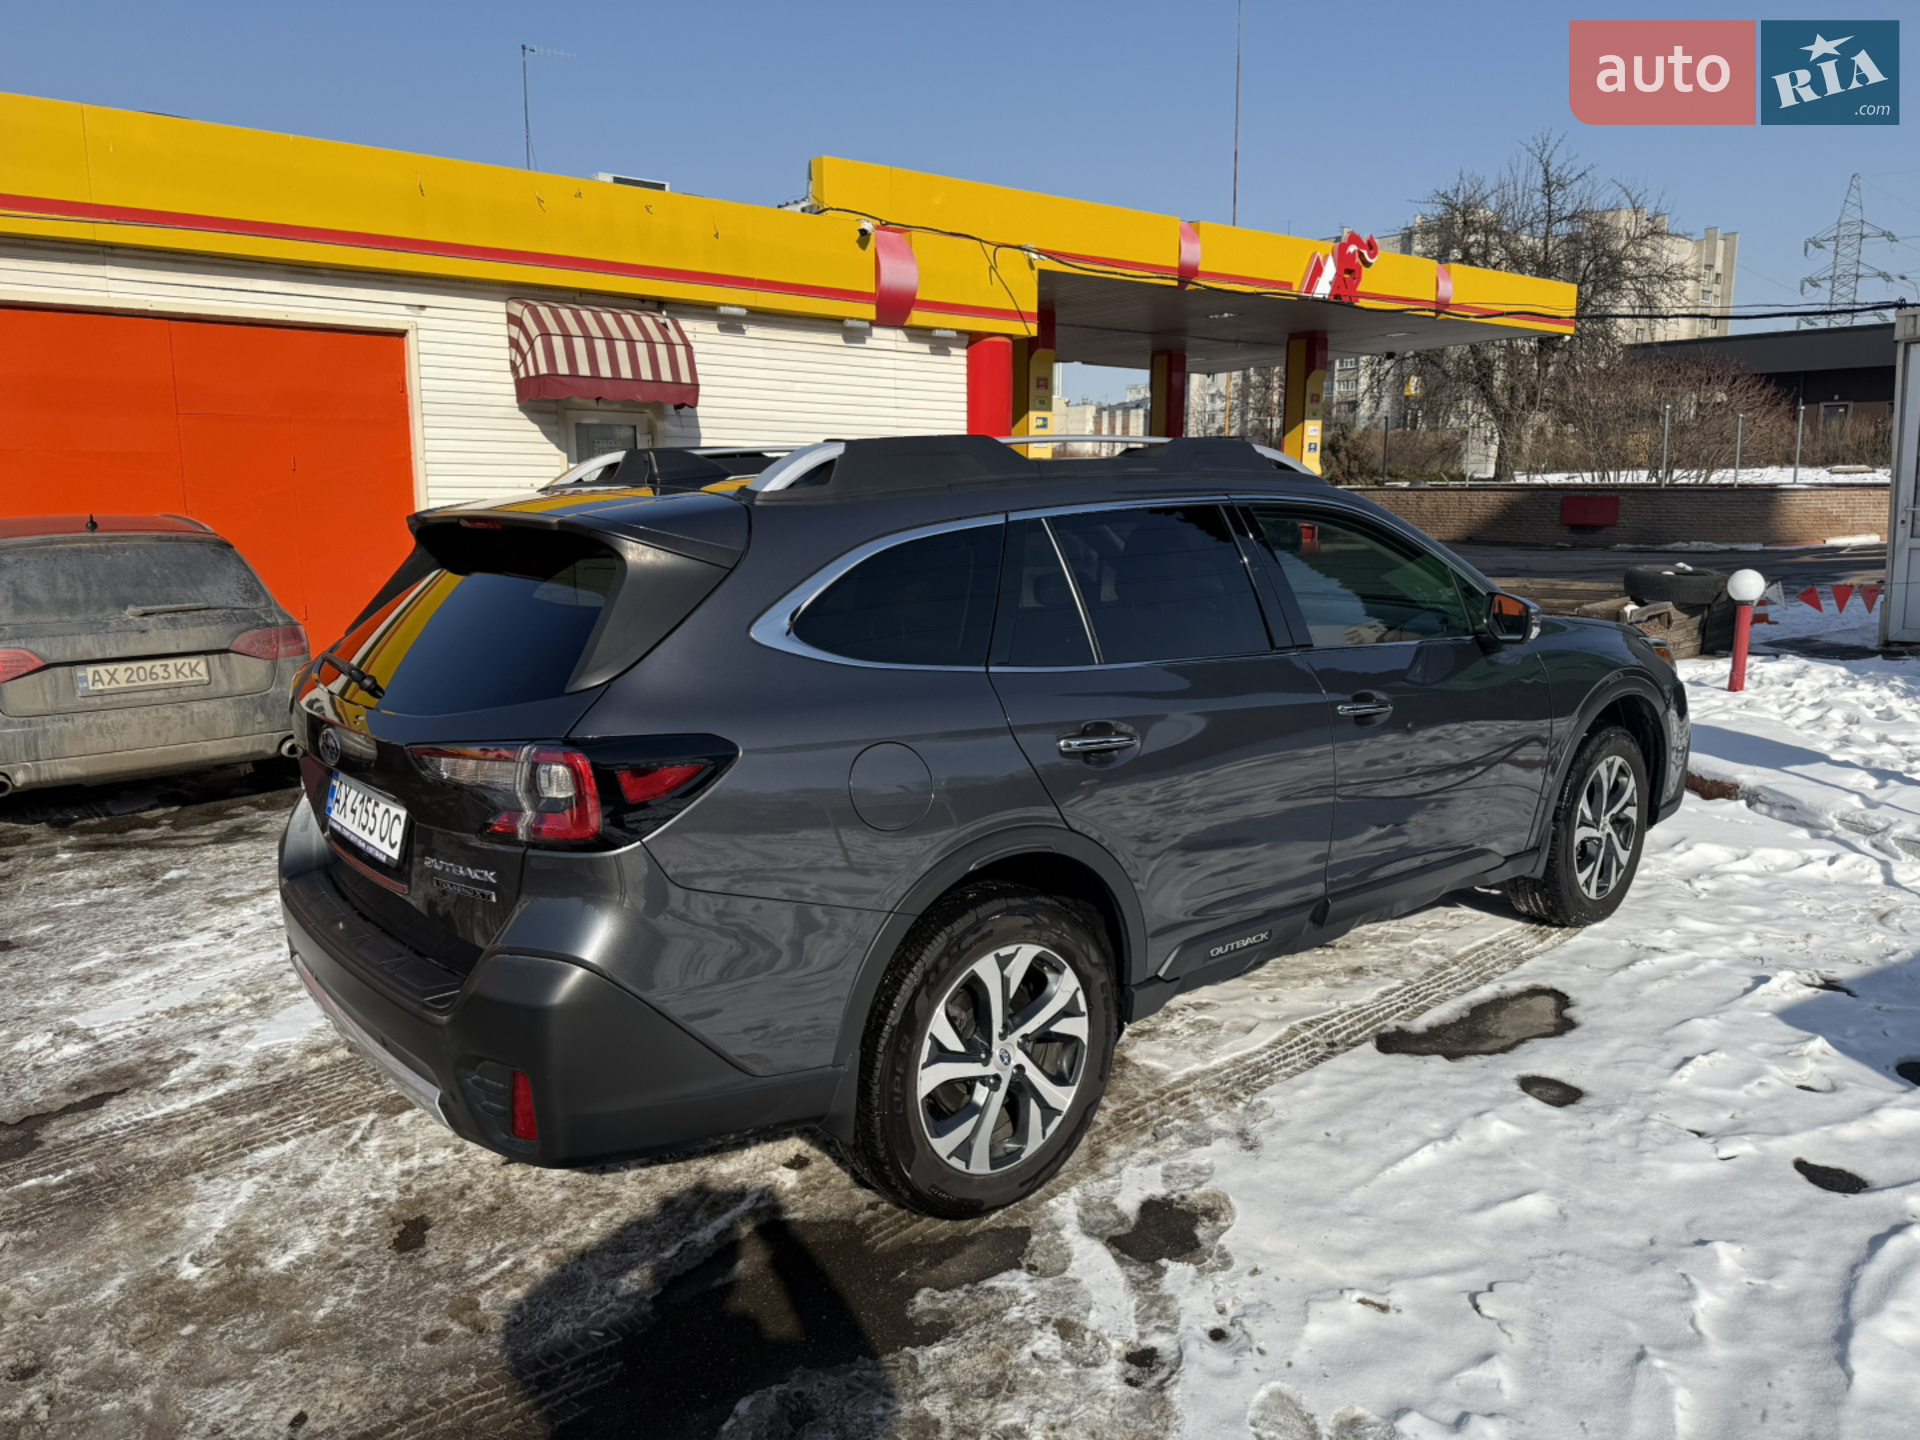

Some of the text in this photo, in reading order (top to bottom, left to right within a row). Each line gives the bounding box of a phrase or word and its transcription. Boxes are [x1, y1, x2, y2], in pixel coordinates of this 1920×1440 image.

[91, 661, 204, 688] AX 2063 KK
[333, 780, 353, 820] AX
[350, 790, 380, 837] 4155
[379, 807, 403, 850] OC
[423, 856, 498, 884] OUTBACK
[1209, 931, 1269, 957] OUTBACK
